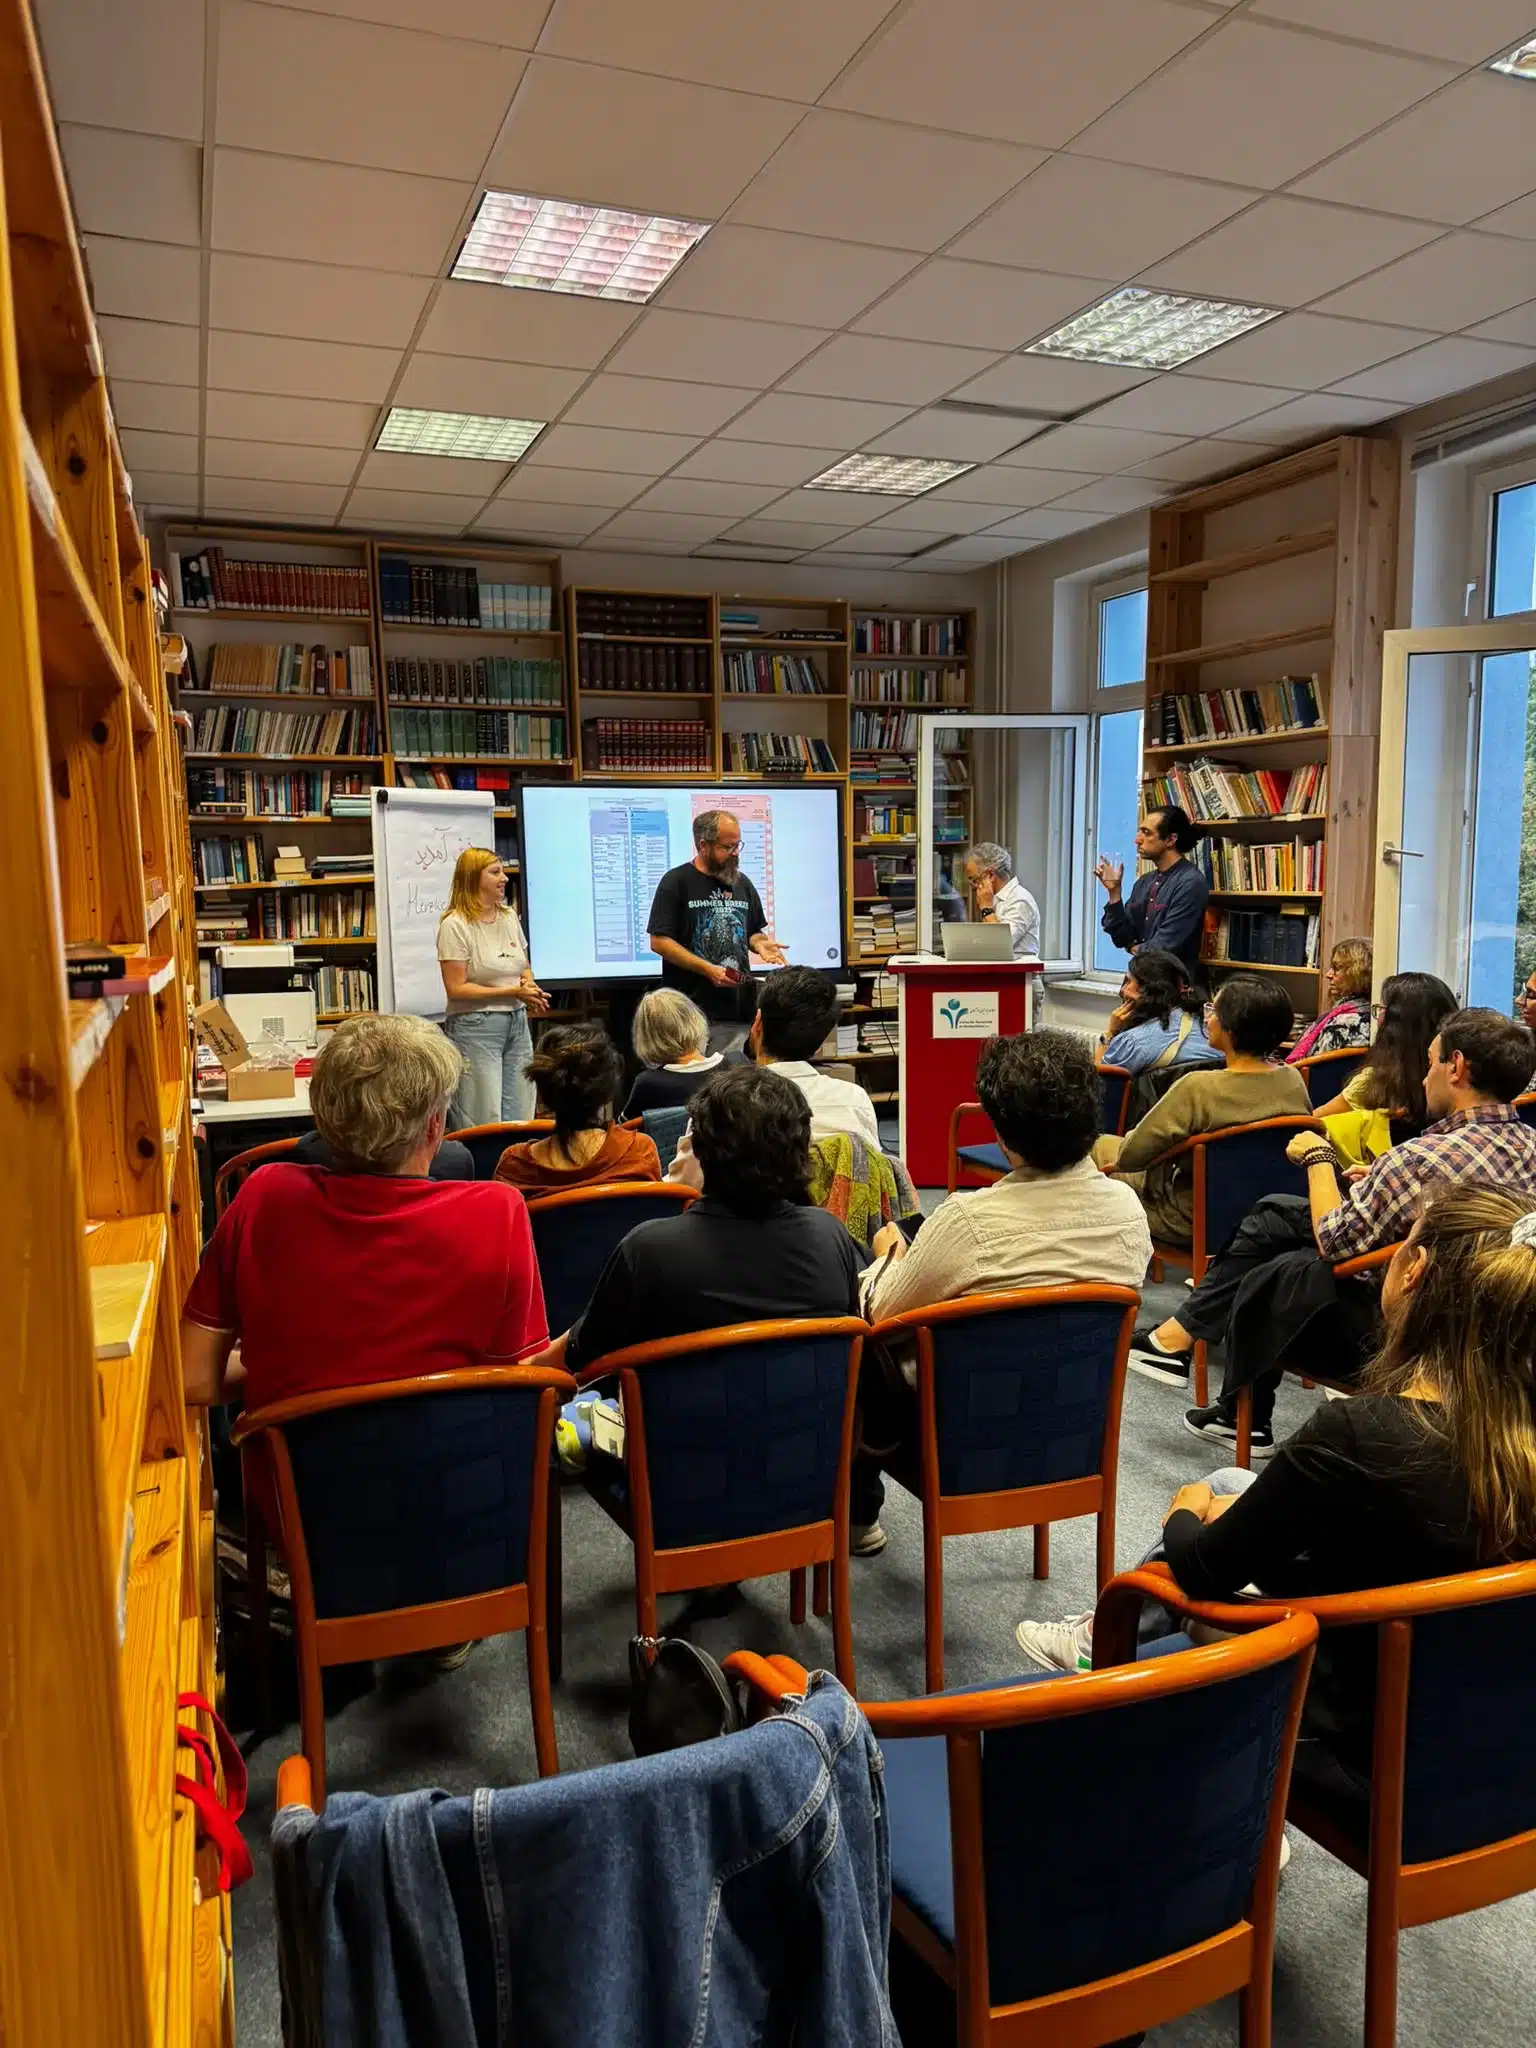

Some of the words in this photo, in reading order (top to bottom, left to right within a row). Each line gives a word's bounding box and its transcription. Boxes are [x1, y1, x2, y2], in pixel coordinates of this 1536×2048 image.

[406, 882, 447, 916] Herzlic
[688, 899, 724, 908] SUMMER
[724, 900, 749, 909] BREEZE
